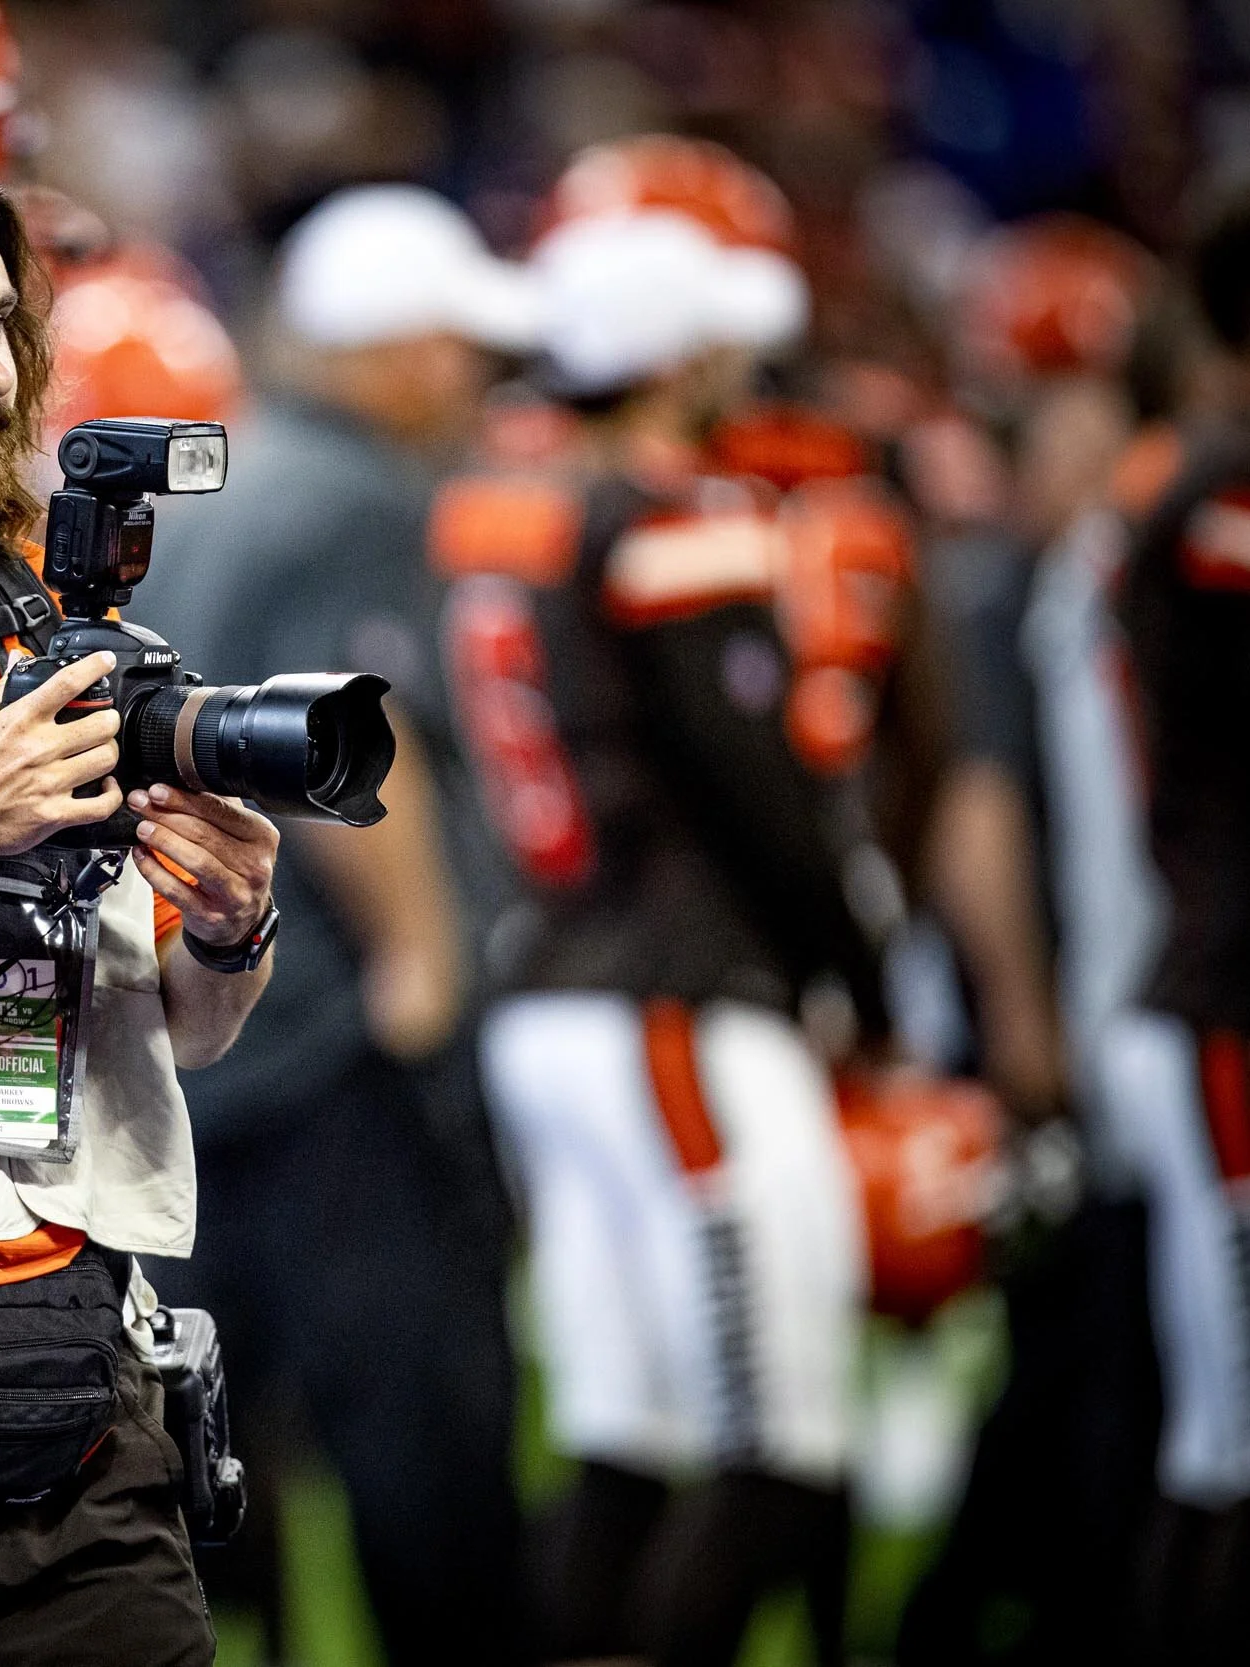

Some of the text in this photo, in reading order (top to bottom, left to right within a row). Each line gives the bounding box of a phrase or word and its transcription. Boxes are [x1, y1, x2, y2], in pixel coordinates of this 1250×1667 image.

[128, 511, 147, 520] Nikon
[144, 651, 172, 665] Nikon
[1, 1097, 34, 1106] BROWNS
